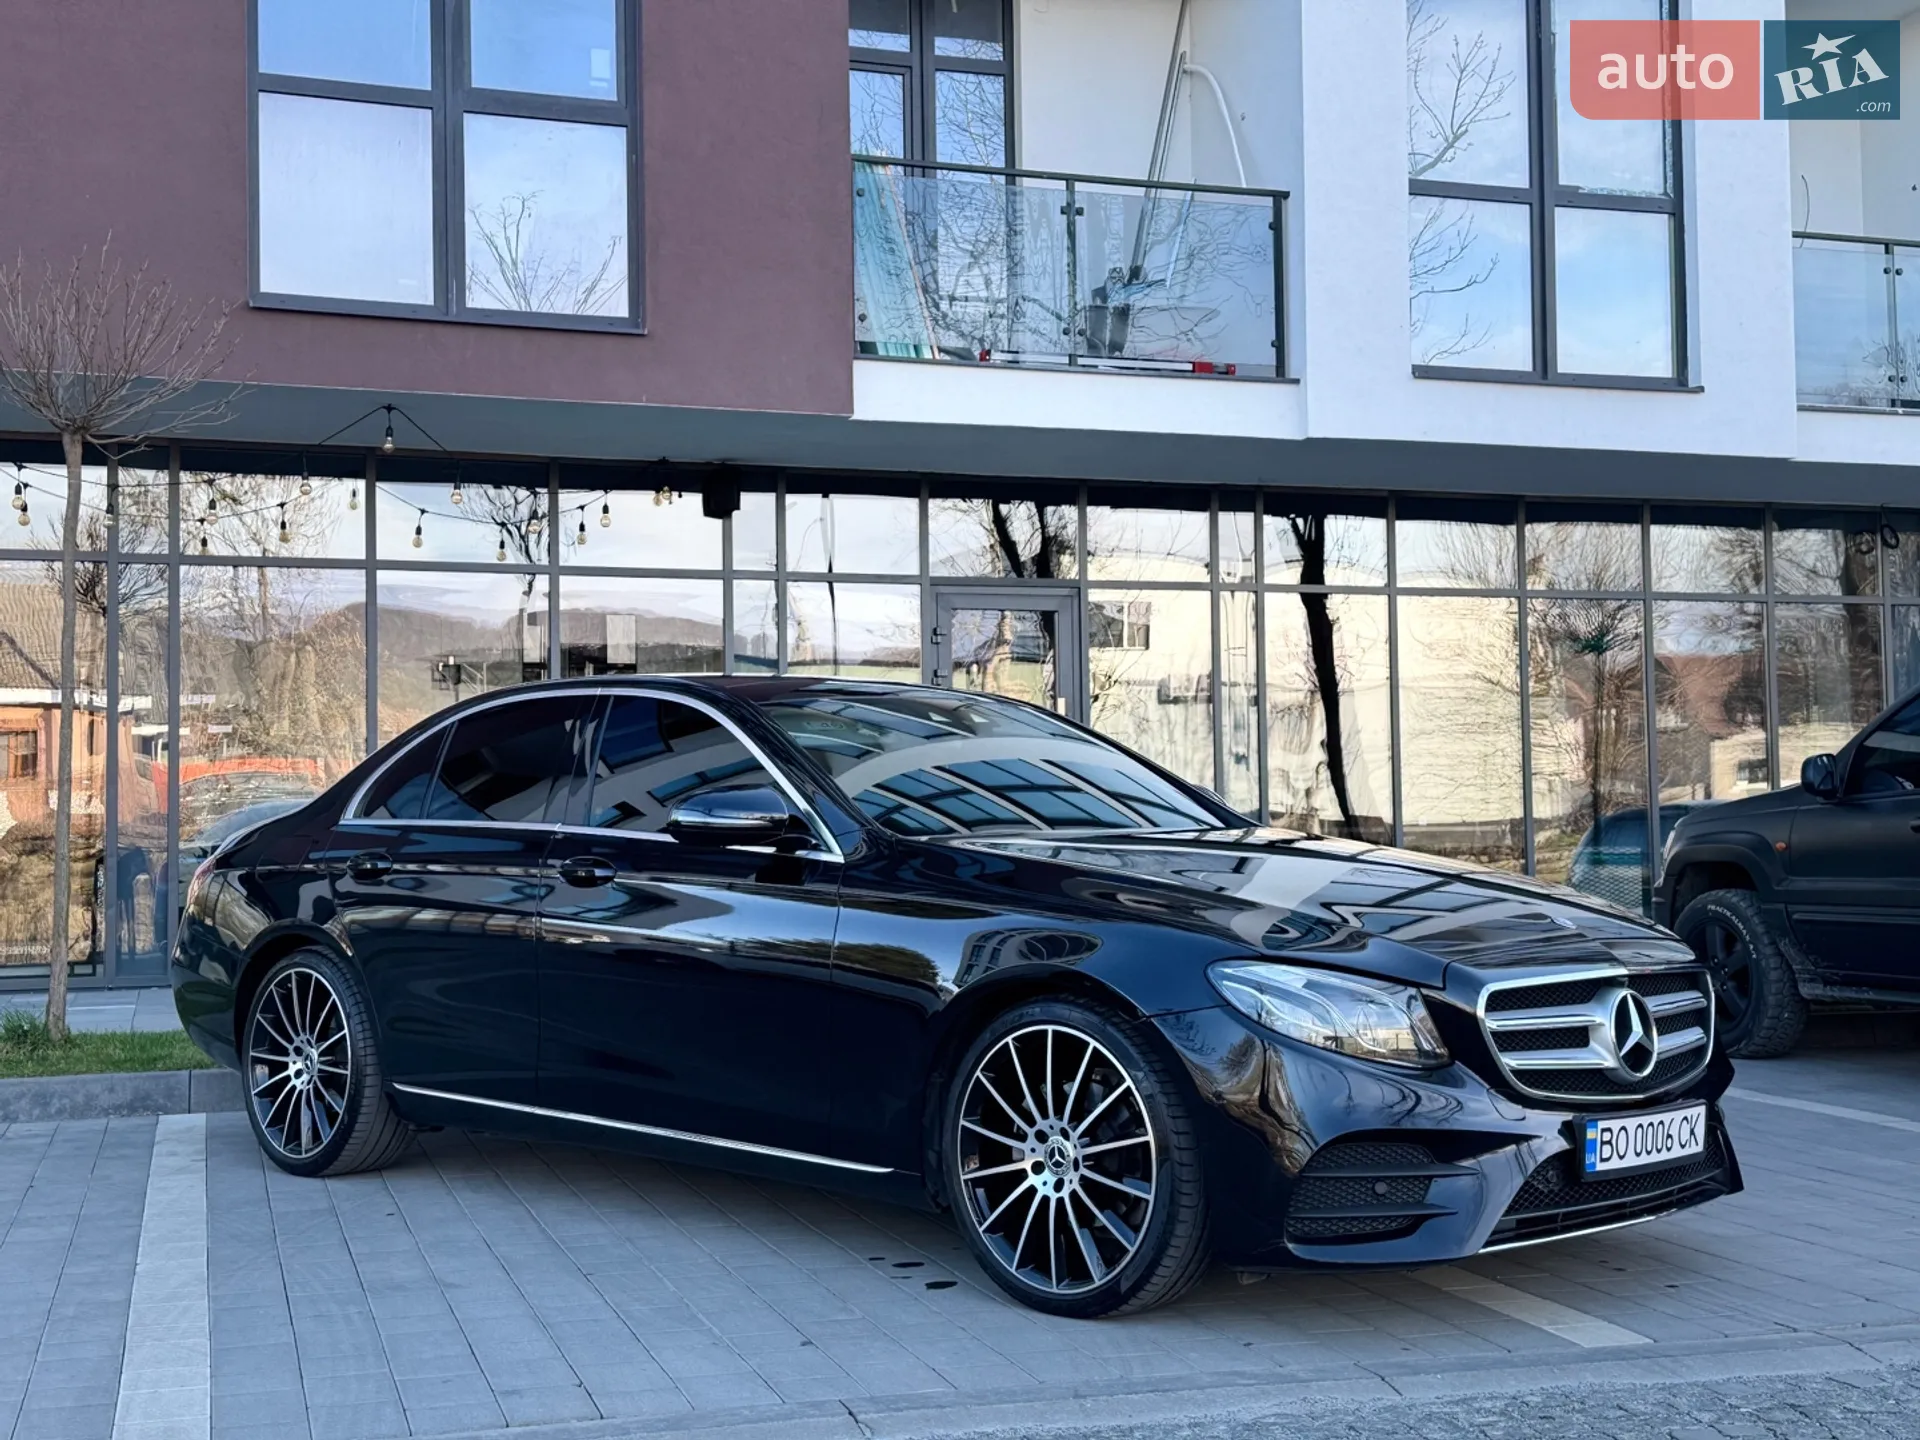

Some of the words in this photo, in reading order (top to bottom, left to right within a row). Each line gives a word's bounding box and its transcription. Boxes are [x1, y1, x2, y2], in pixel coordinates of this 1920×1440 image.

[1599, 1125, 1629, 1163] BO
[1634, 1117, 1675, 1158] 0006
[1678, 1112, 1701, 1150] CK
[1585, 1152, 1596, 1164] UA
